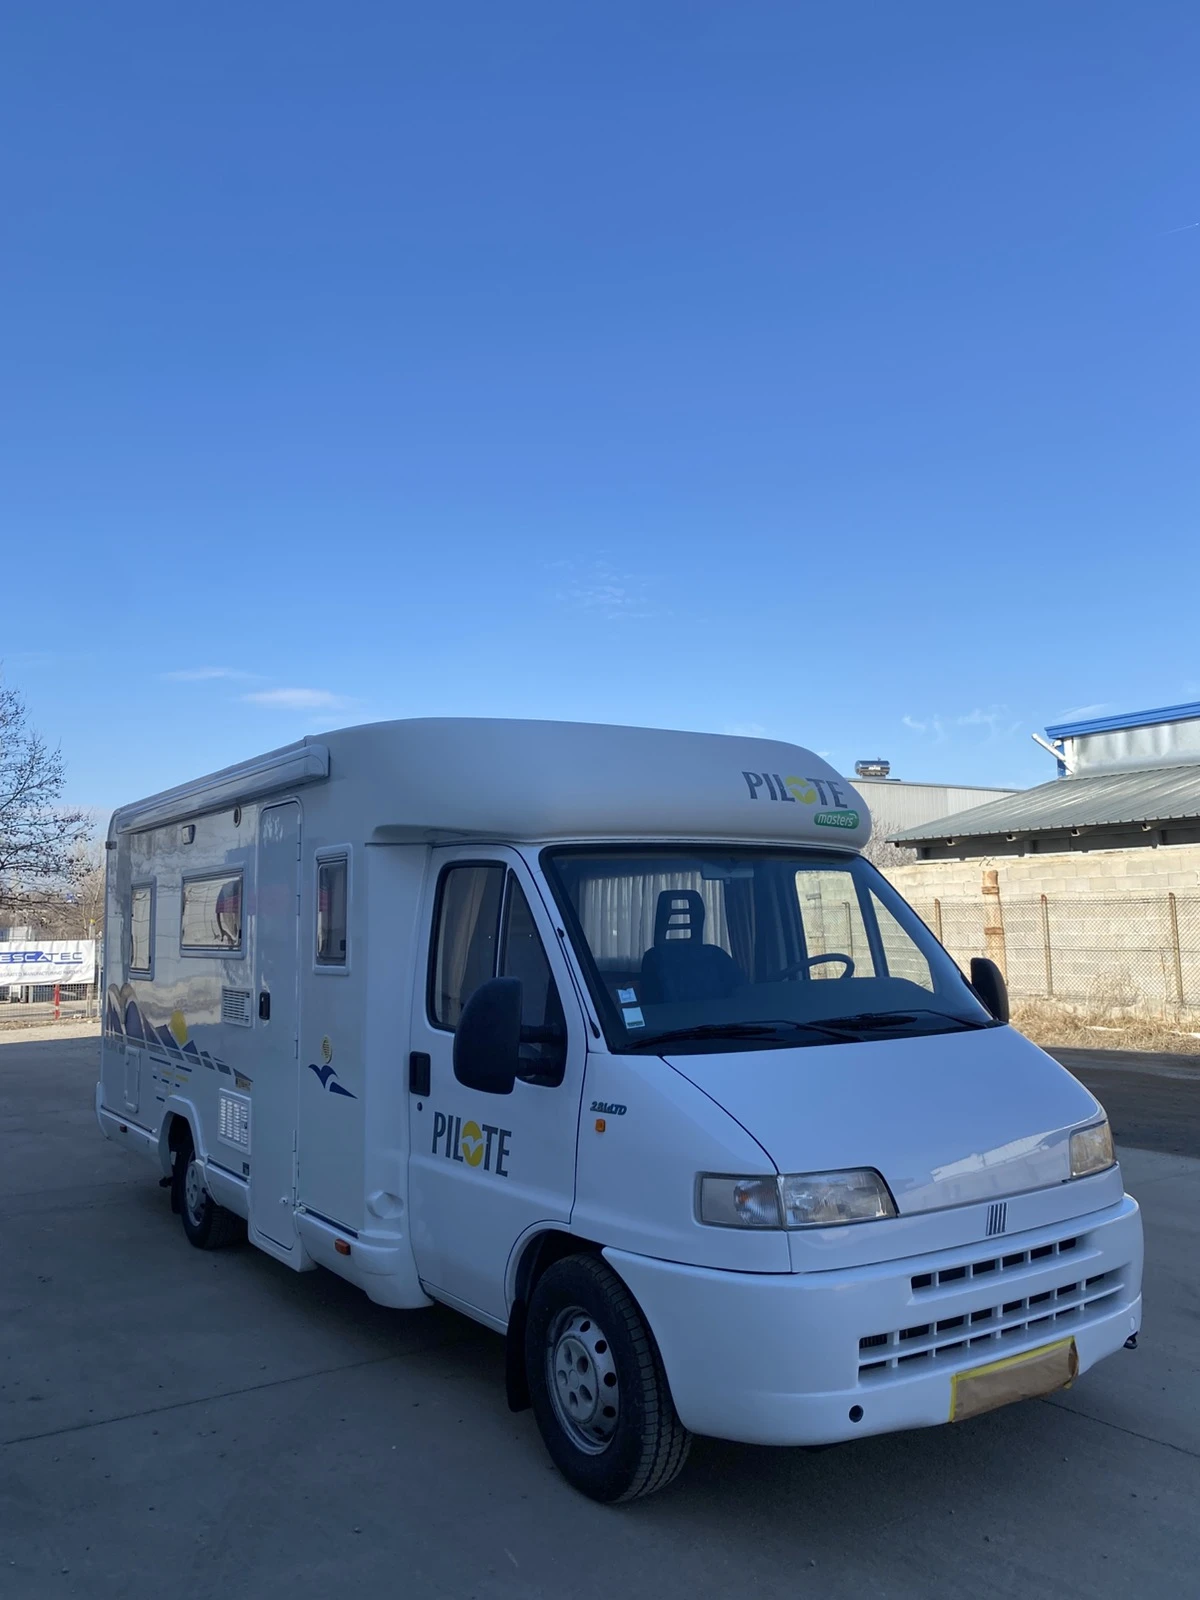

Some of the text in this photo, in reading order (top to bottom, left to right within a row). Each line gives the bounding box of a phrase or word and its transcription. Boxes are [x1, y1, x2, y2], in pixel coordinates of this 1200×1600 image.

[742, 771, 848, 808] PILOTE
[817, 813, 854, 827] masters
[0, 952, 83, 963] ESCATEC
[432, 1111, 512, 1177] PILOTE
